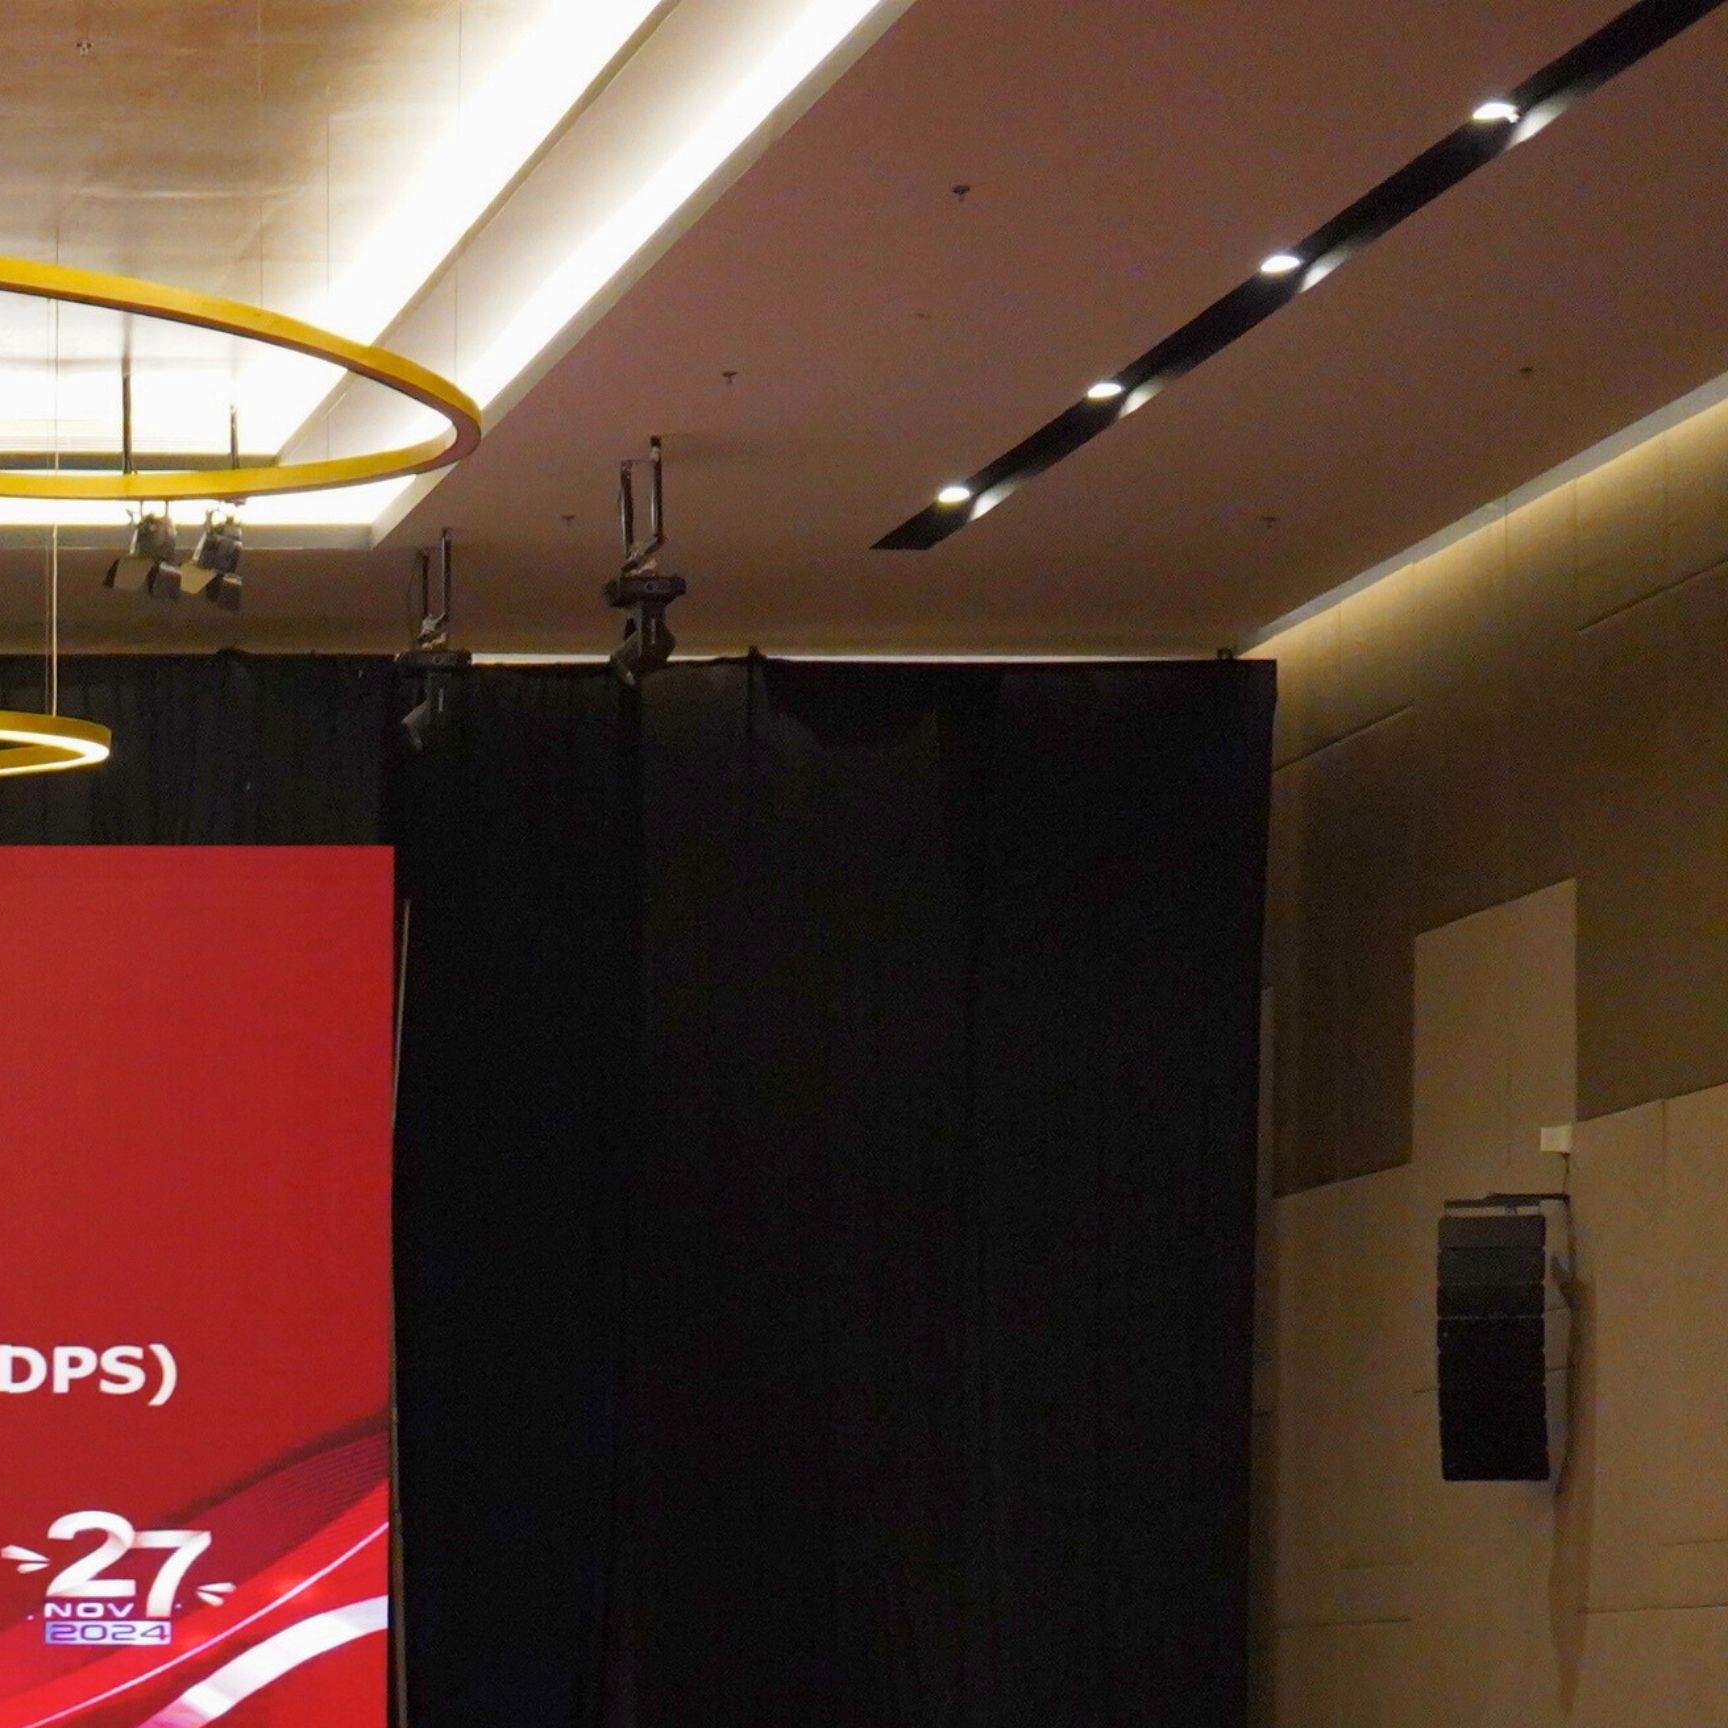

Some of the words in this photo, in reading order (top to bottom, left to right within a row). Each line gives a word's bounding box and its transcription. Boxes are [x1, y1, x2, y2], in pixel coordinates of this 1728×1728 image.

[46, 1510, 211, 1618] 27
[44, 1602, 134, 1619] NOV
[49, 1622, 169, 1642] 2024
